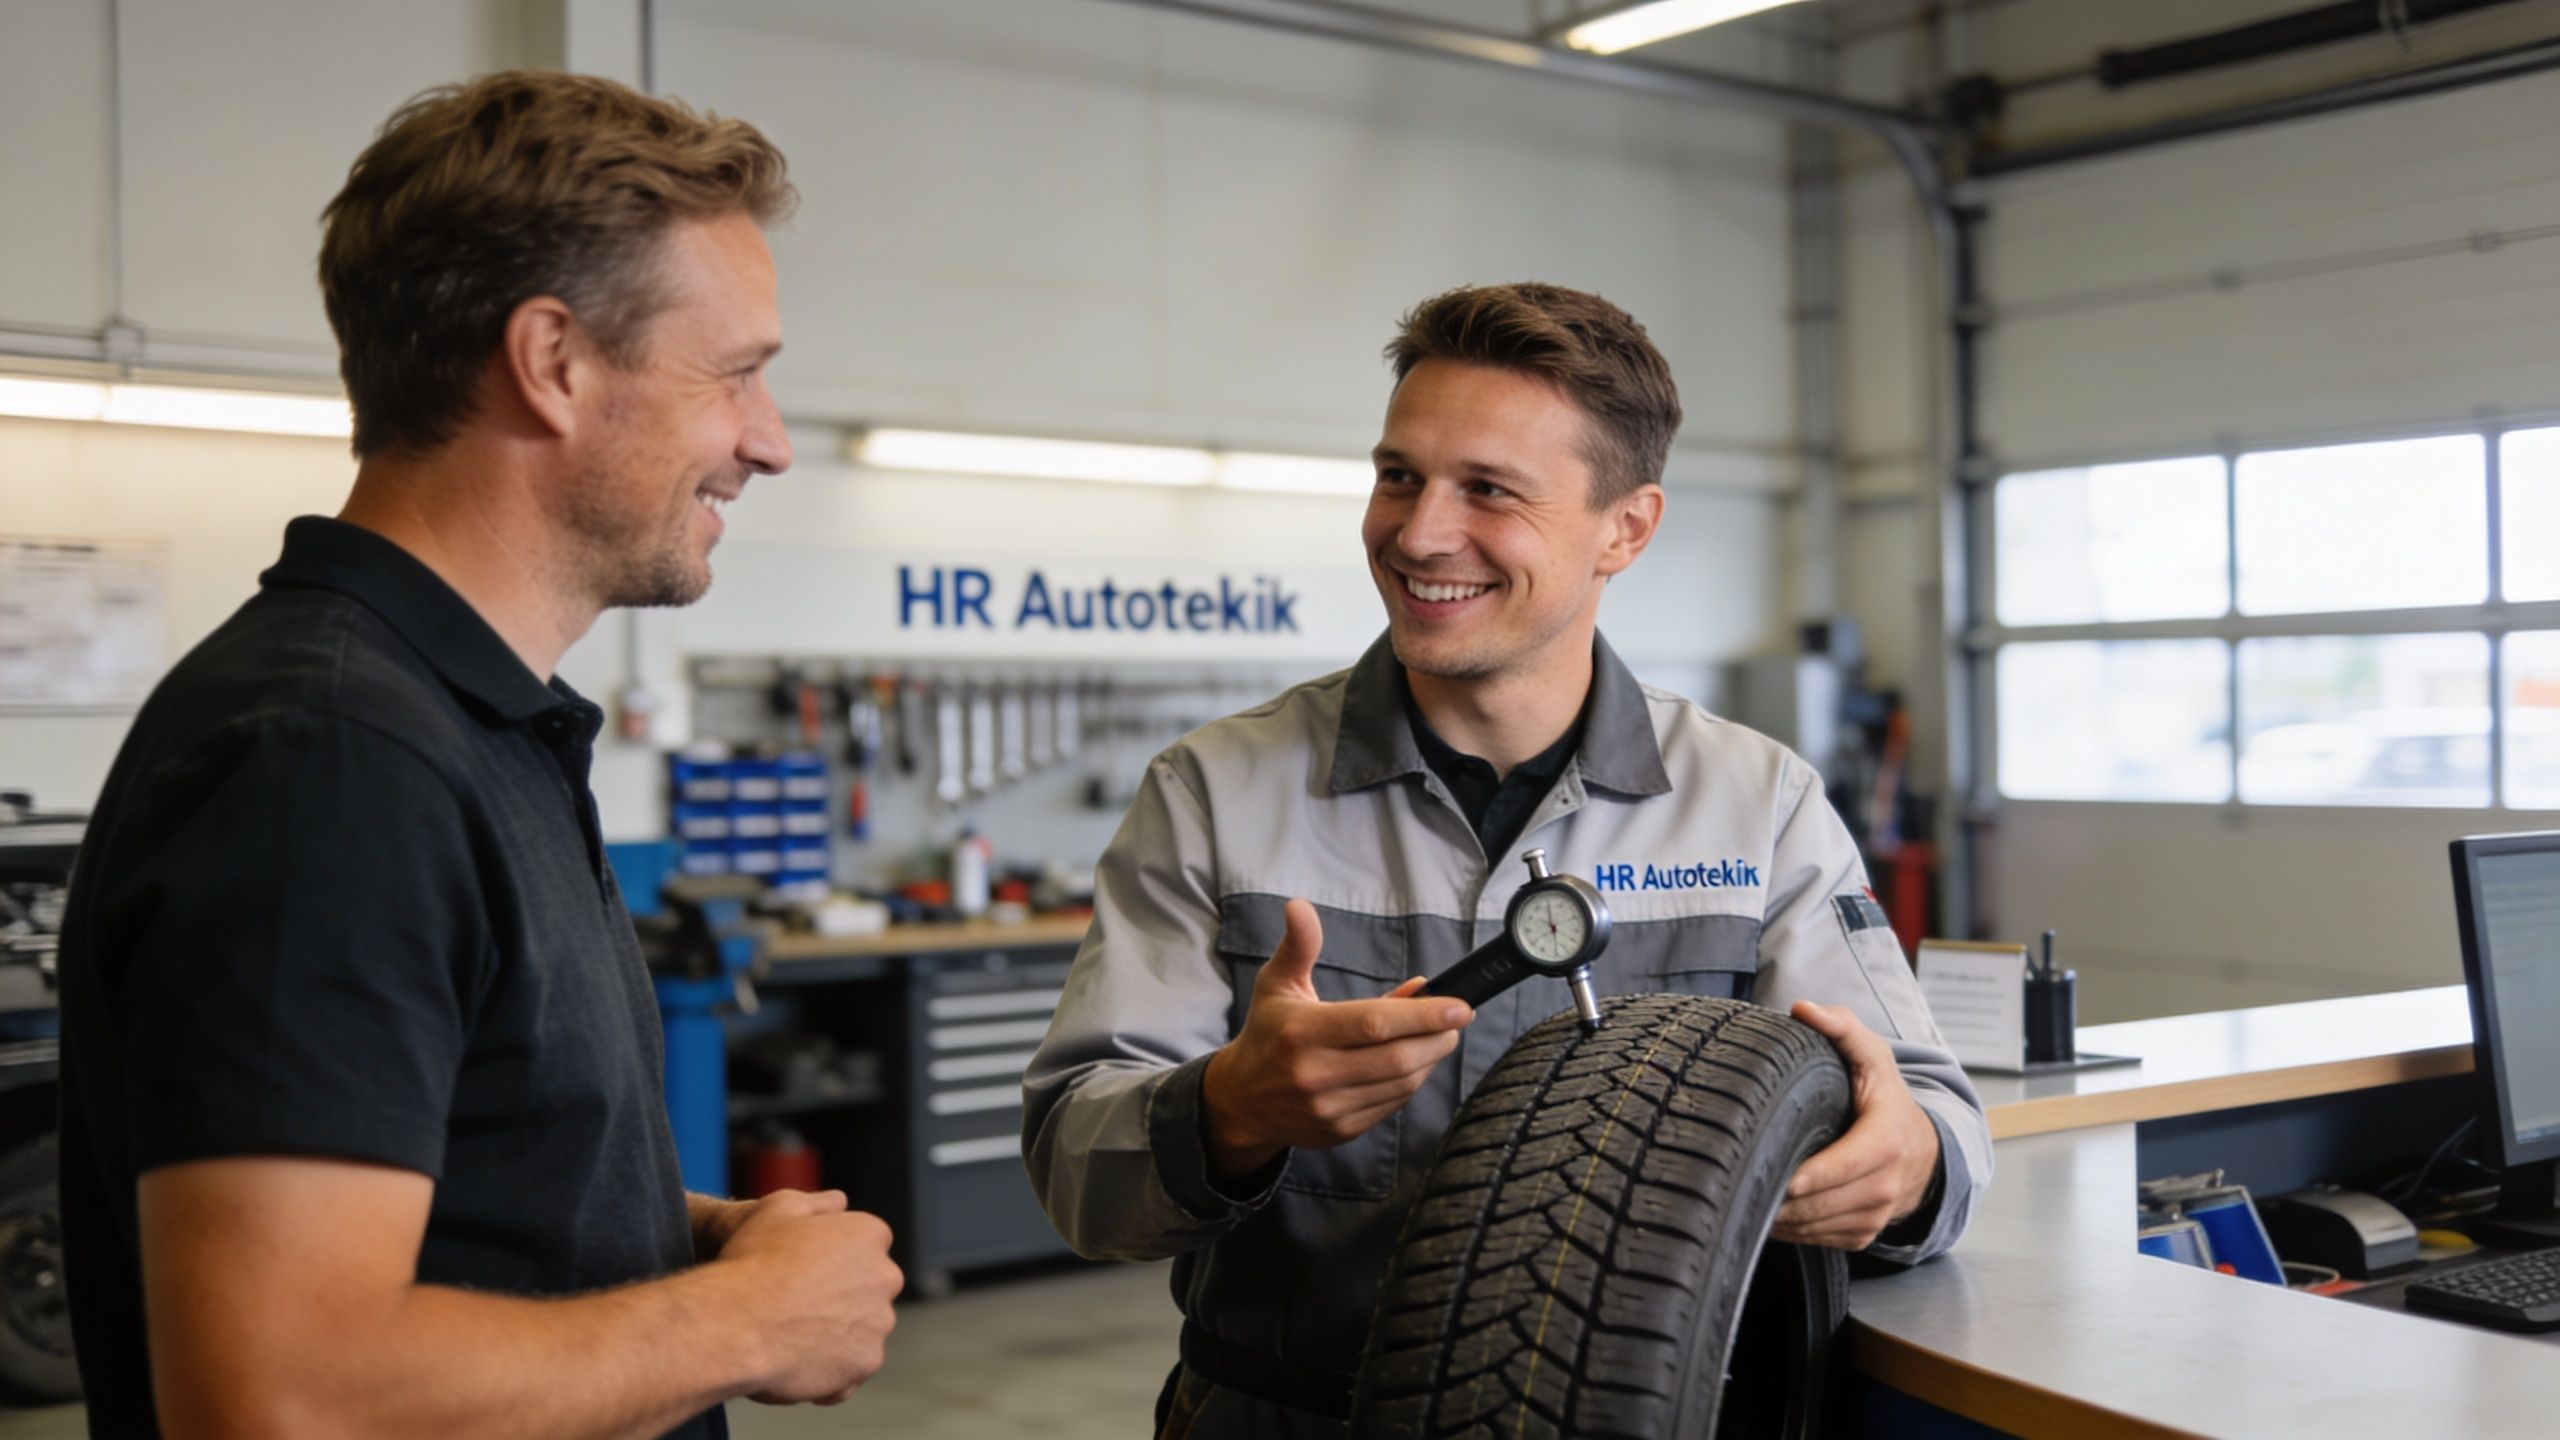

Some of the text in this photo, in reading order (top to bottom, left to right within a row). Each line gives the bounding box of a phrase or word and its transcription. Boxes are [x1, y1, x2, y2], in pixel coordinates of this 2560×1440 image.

[899, 566, 1298, 631] HR Autotekik
[1596, 864, 1636, 890] HR
